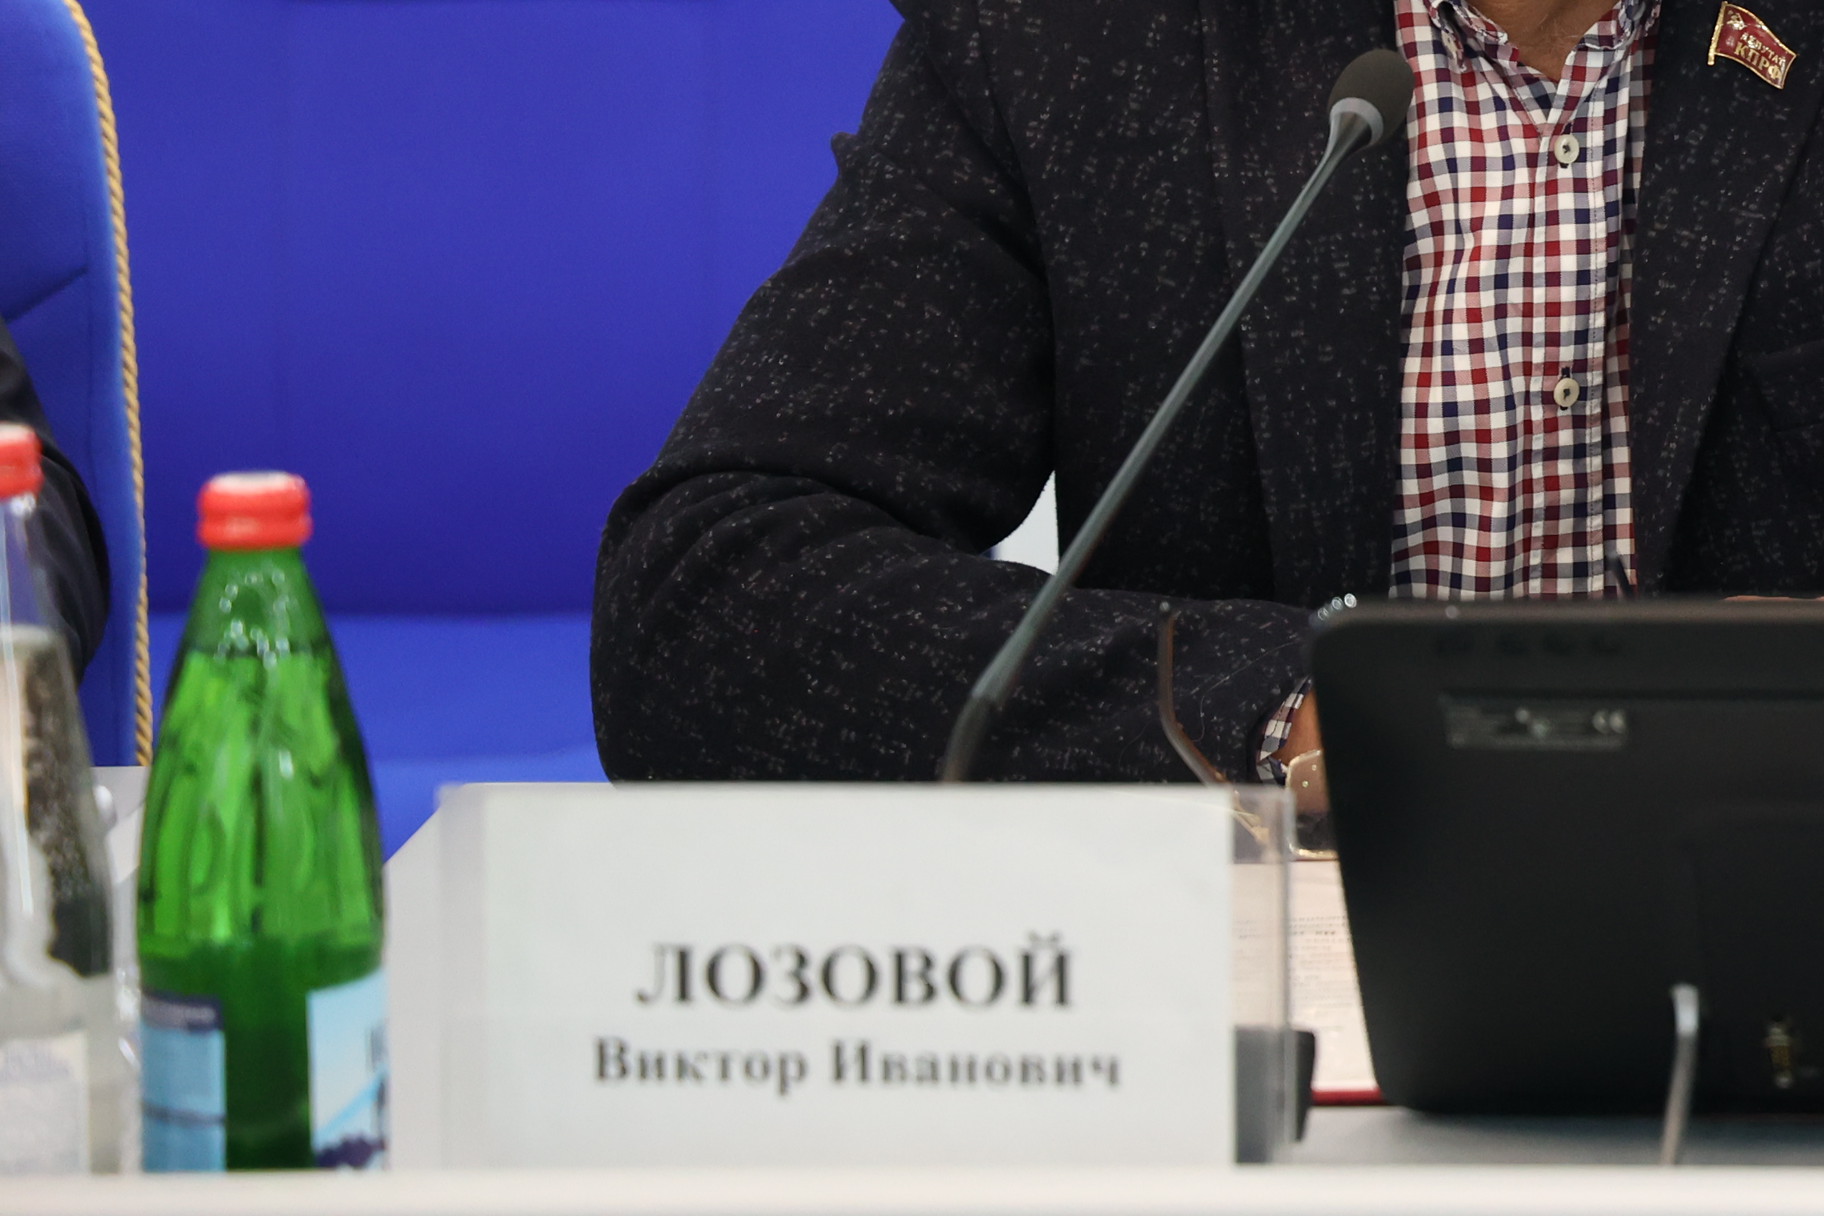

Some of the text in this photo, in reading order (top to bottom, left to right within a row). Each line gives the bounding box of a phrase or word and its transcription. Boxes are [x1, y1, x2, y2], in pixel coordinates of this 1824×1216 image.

[1734, 43, 1782, 79] КПРФ
[636, 931, 1074, 1008] ЛОЗОВОЙ
[594, 1037, 1121, 1098] Виктор Иванович
